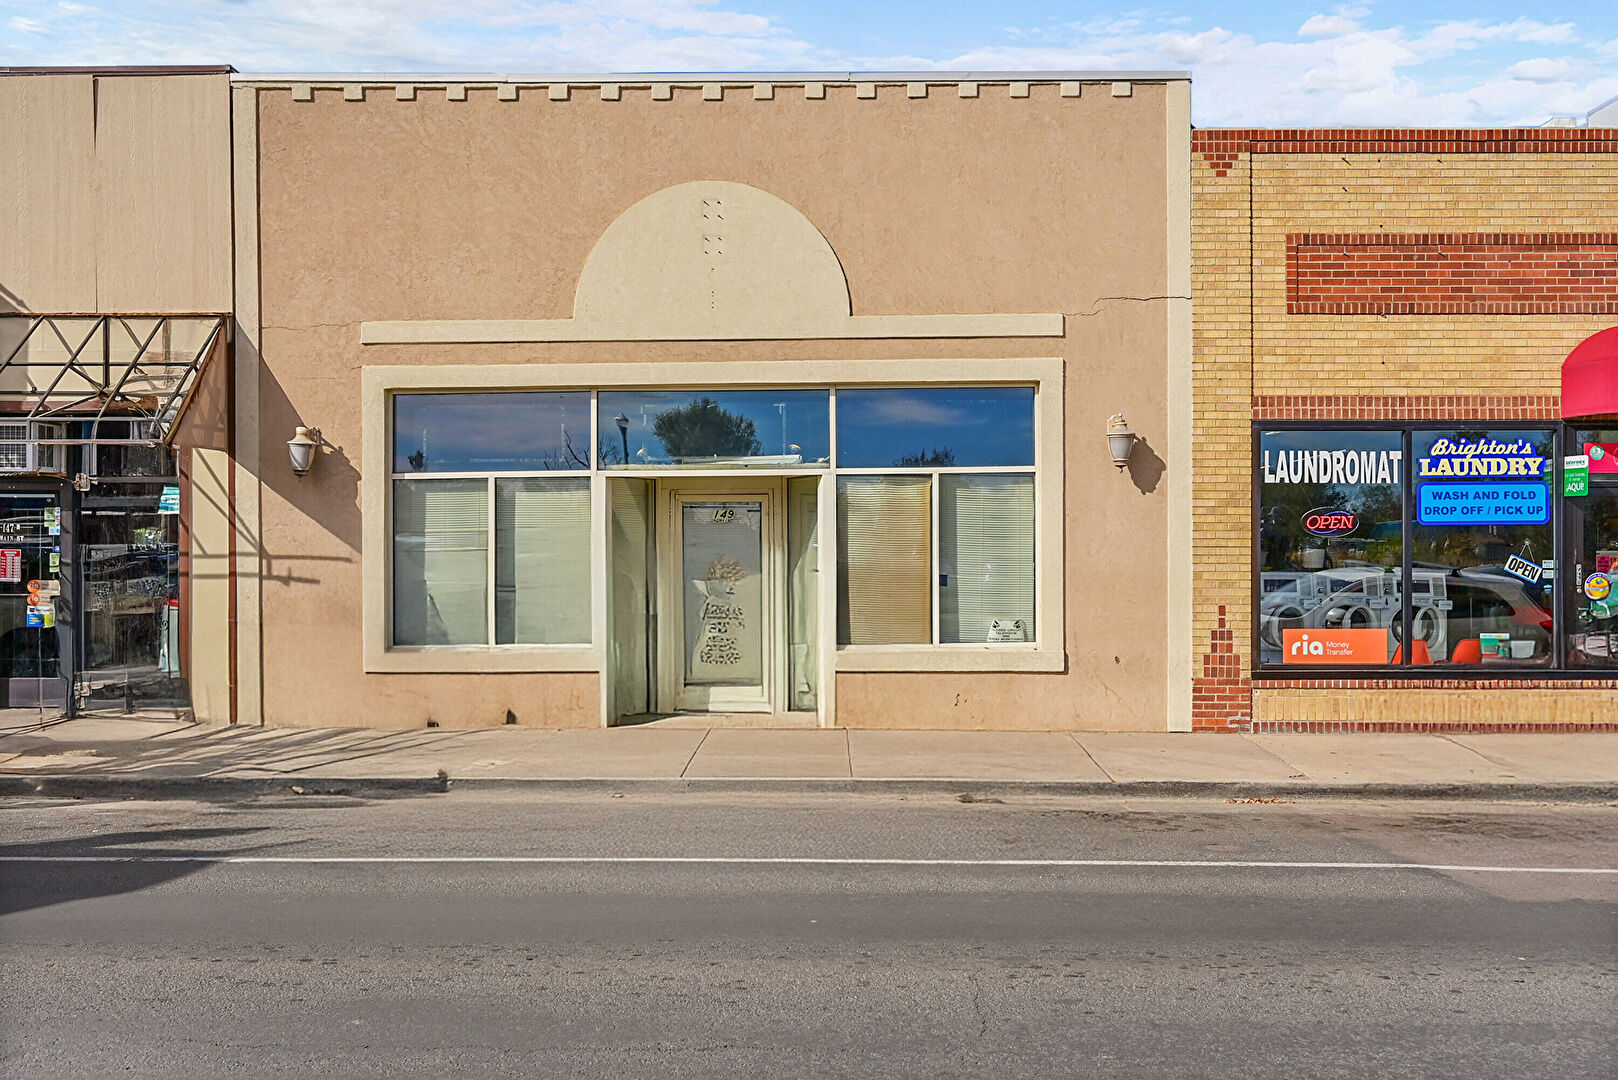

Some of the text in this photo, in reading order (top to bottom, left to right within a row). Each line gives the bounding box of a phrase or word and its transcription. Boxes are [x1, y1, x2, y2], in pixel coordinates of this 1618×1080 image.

[1430, 438, 1532, 459] Brighton's
[1264, 450, 1402, 485] LAUNDROMAT
[1419, 457, 1544, 476] LAUNDRY
[1432, 491, 1536, 500] WASH AND FOLD
[714, 509, 735, 519] 149
[1424, 506, 1457, 515] DROP
[1461, 506, 1484, 515] OFF
[1494, 506, 1524, 515] PICK
[1527, 506, 1544, 515] UP
[3, 522, 15, 533] 147
[1306, 515, 1355, 530] OPEN
[1508, 557, 1540, 581] OPEN
[1291, 634, 1324, 655] ria
[1326, 641, 1350, 649] Money
